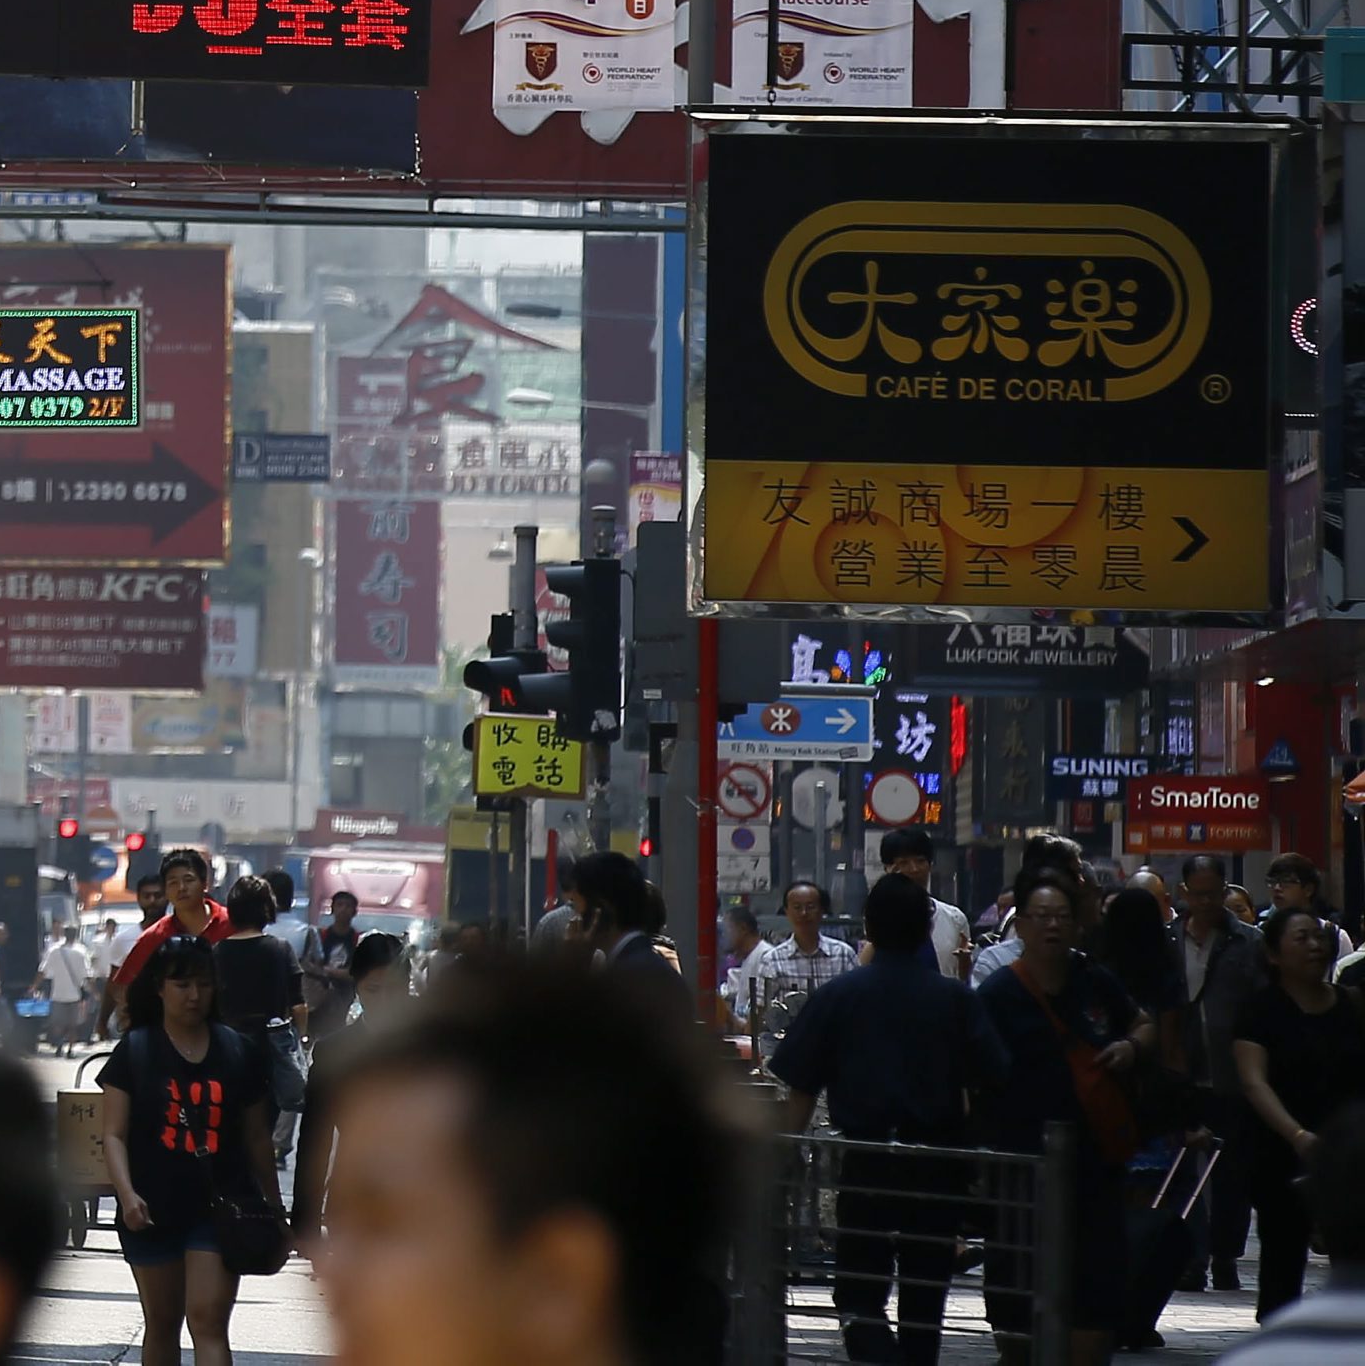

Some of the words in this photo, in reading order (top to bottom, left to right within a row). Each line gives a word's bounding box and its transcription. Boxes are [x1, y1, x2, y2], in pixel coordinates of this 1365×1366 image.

[875, 370, 949, 401] CAFÉ
[958, 377, 998, 401] DE
[1004, 379, 1102, 403] CORAL
[30, 396, 85, 419] 0379
[87, 396, 126, 418] 2/F
[762, 477, 1148, 532] 友誠商場一樓
[829, 537, 1148, 592] 營業至零晨
[98, 574, 184, 602] KFC
[1024, 649, 1118, 667] JEWELLERY
[491, 754, 564, 786] 電話
[1052, 758, 1149, 777] SUNING
[1150, 785, 1260, 809] SmarTone
